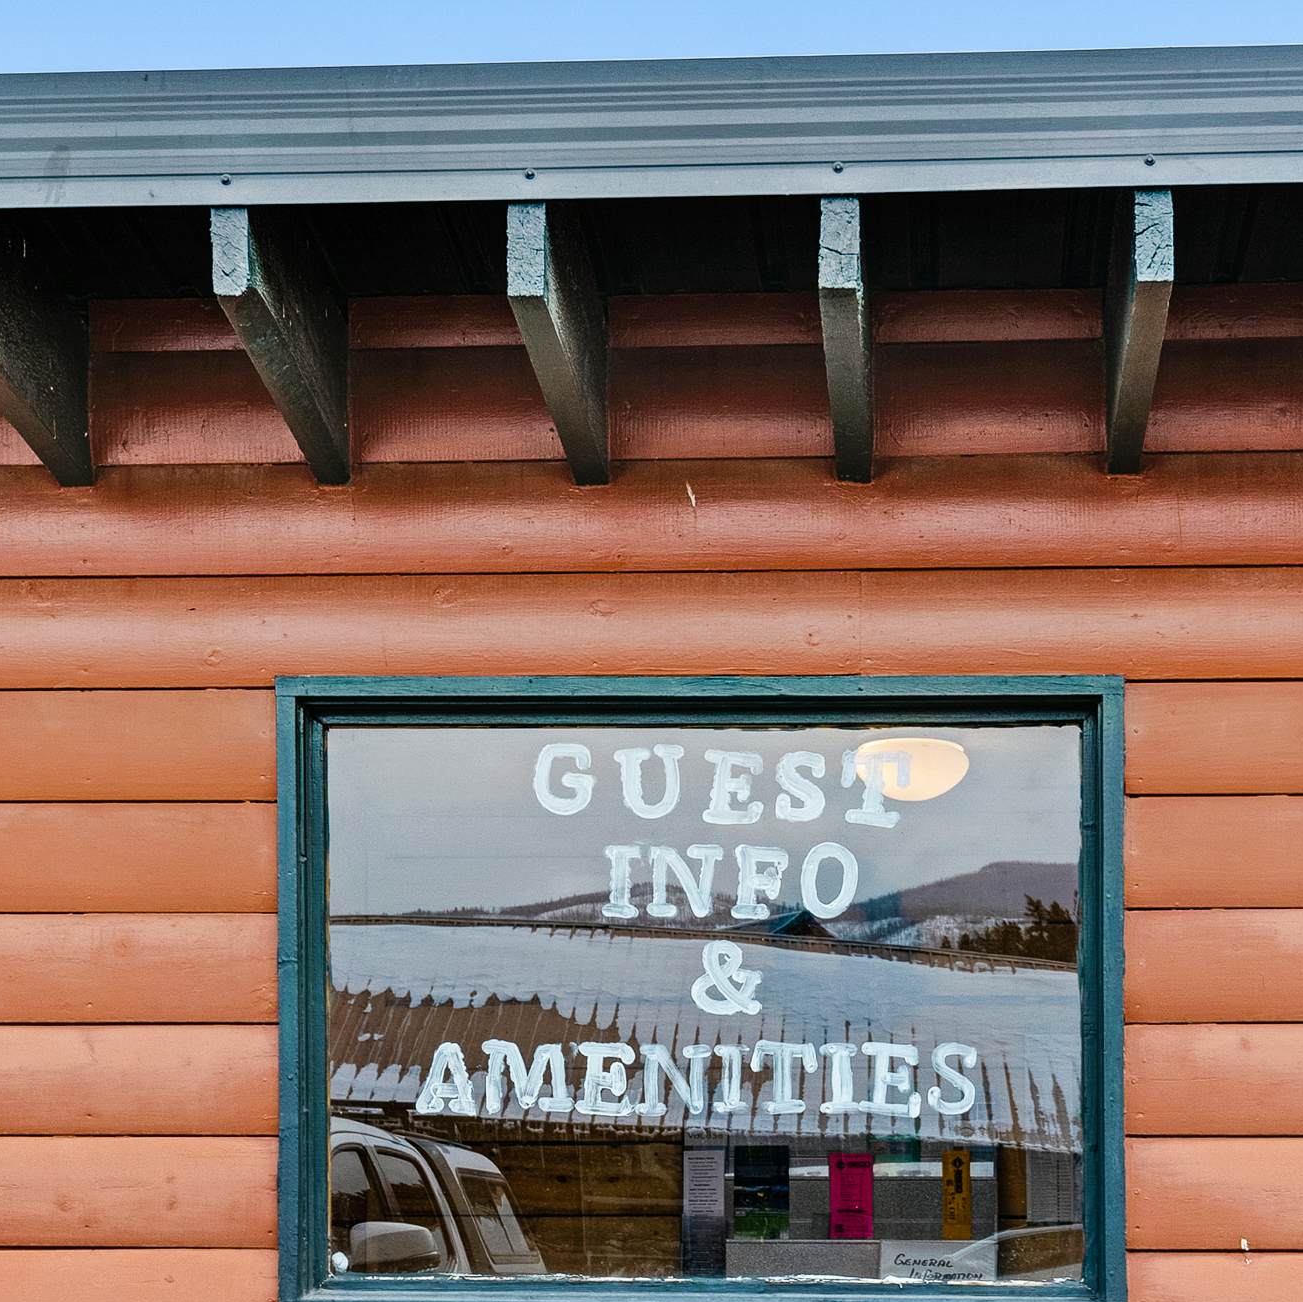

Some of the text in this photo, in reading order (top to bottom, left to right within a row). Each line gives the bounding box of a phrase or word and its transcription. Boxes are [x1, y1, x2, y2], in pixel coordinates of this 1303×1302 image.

[534, 743, 911, 828] GUEST
[603, 841, 860, 920] INFO
[690, 940, 763, 1016] &
[416, 1040, 979, 1118] AMENITIES
[894, 1253, 954, 1268] GENERAL
